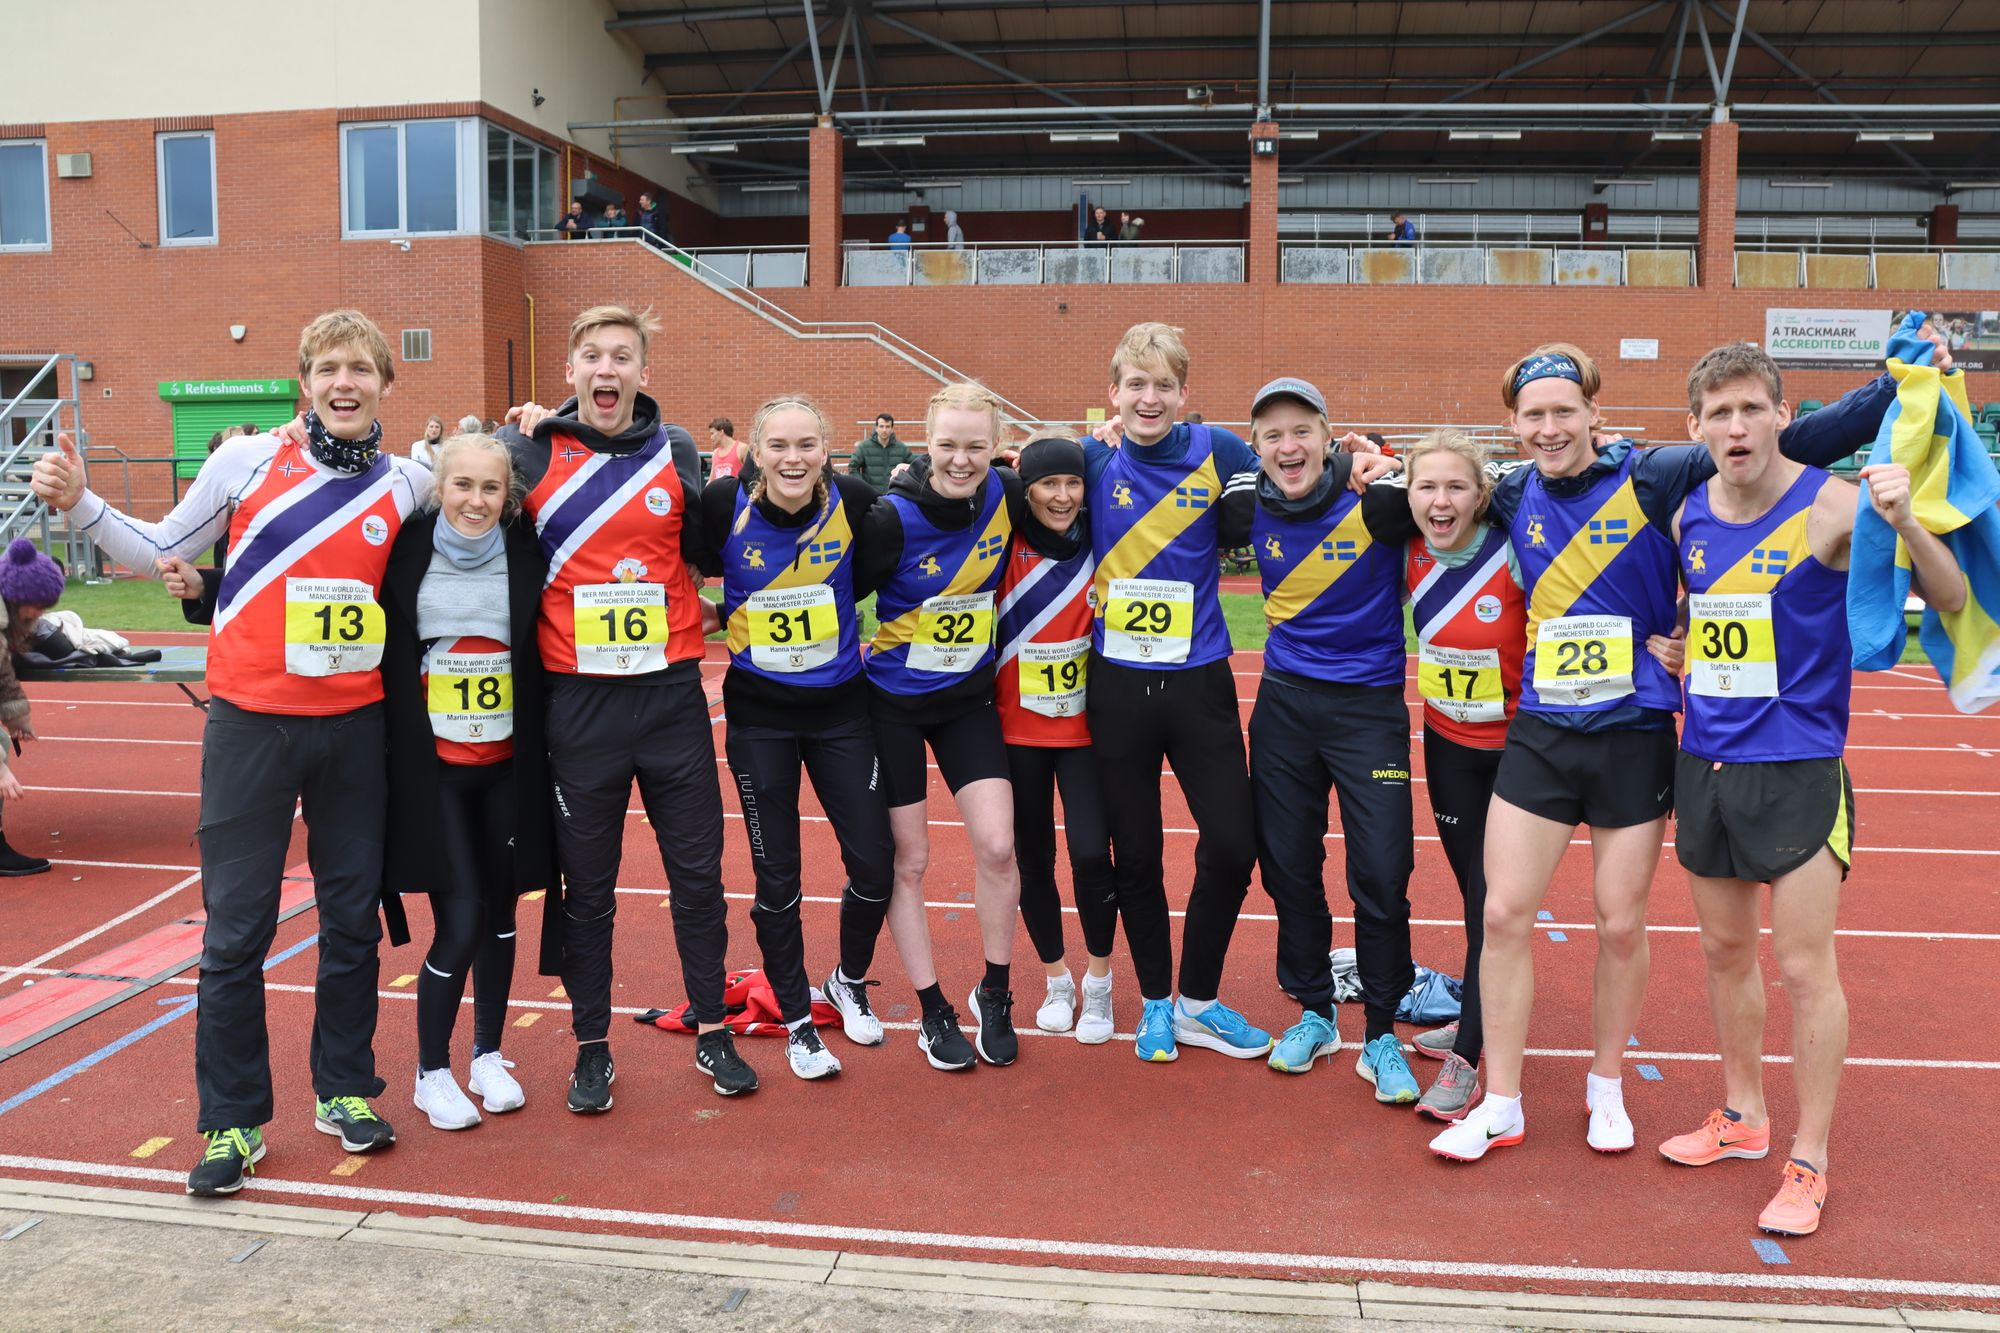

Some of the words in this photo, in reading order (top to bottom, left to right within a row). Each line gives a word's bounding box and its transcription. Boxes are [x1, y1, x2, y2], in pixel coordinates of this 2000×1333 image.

[1772, 339, 1845, 349] ACCREDITED
[1849, 340, 1879, 350] CLUB
[1773, 327, 1780, 336] A
[1784, 327, 1856, 337] TRACKMARK
[185, 383, 263, 394] Refreshments
[315, 605, 363, 640] 13
[600, 608, 647, 641] 16
[769, 610, 811, 642] 31
[933, 613, 974, 643] 32
[1125, 601, 1171, 633] 29
[1071, 641, 1087, 650] CLASSIC
[1703, 622, 1748, 659] 30
[1435, 657, 1465, 666] MANCHESTER
[1557, 640, 1607, 676] 28
[1041, 661, 1078, 691] 19
[1439, 669, 1478, 699] 17
[454, 677, 501, 710] 18
[738, 774, 753, 792] LIU
[1372, 770, 1409, 779] SWEDEN
[555, 781, 571, 816] RIMTEX
[743, 795, 765, 859] ELITIDROTT
